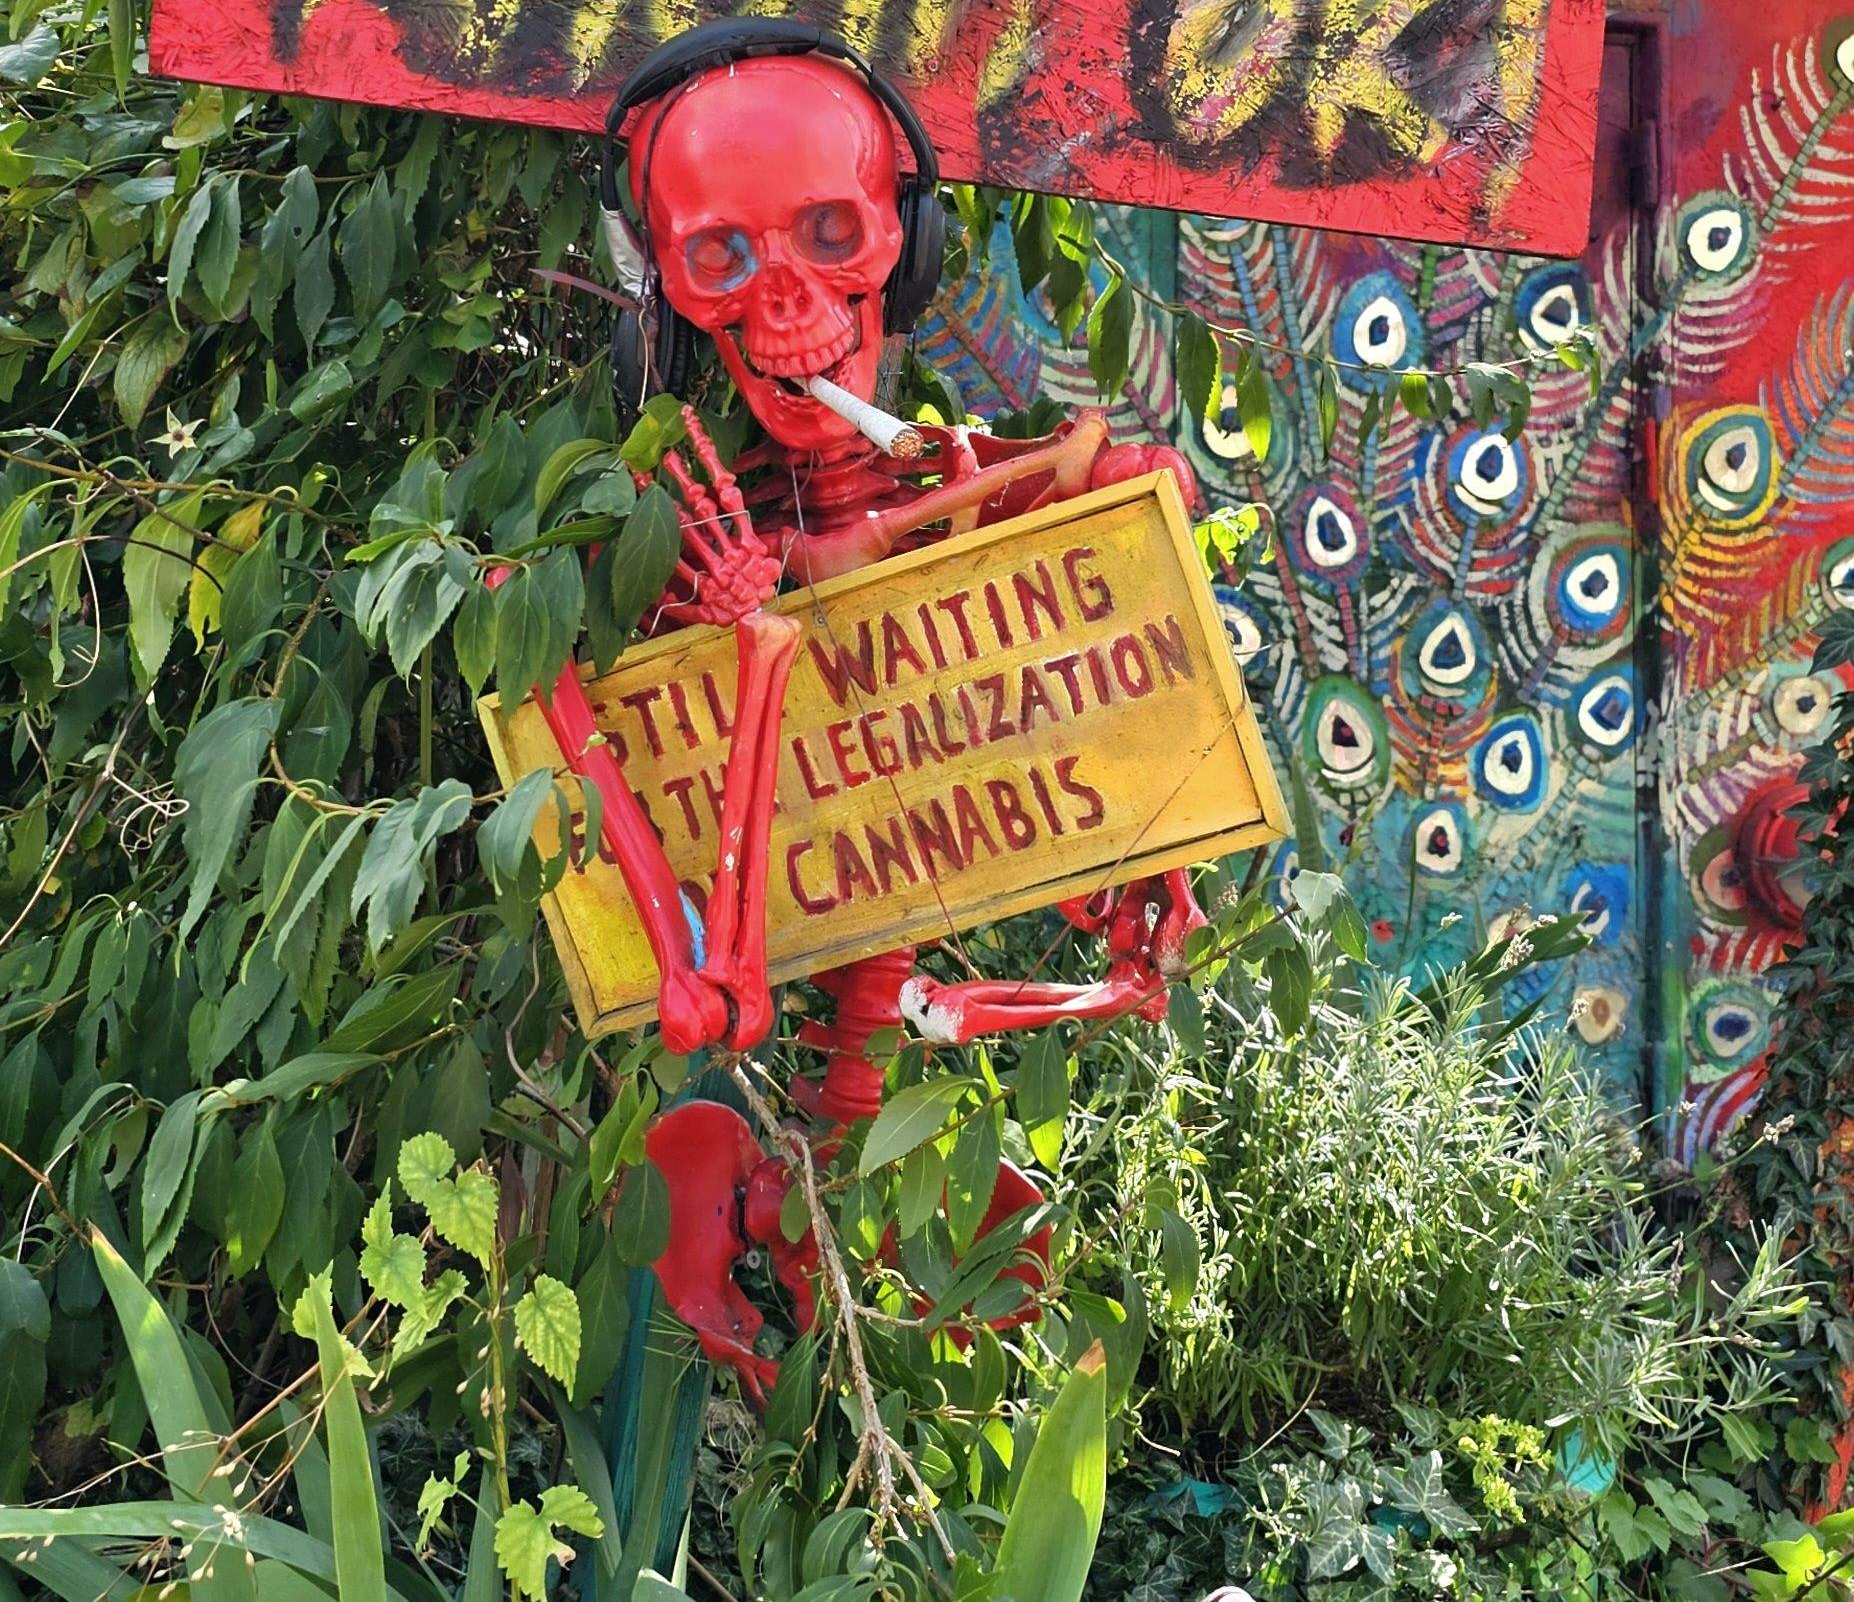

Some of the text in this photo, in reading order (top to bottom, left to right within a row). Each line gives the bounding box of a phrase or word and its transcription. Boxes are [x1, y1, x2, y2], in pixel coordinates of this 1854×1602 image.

[791, 614, 1195, 800] LEGALIZATION
[808, 547, 1115, 708] WAITING
[787, 755, 1105, 916] CANNABIS
